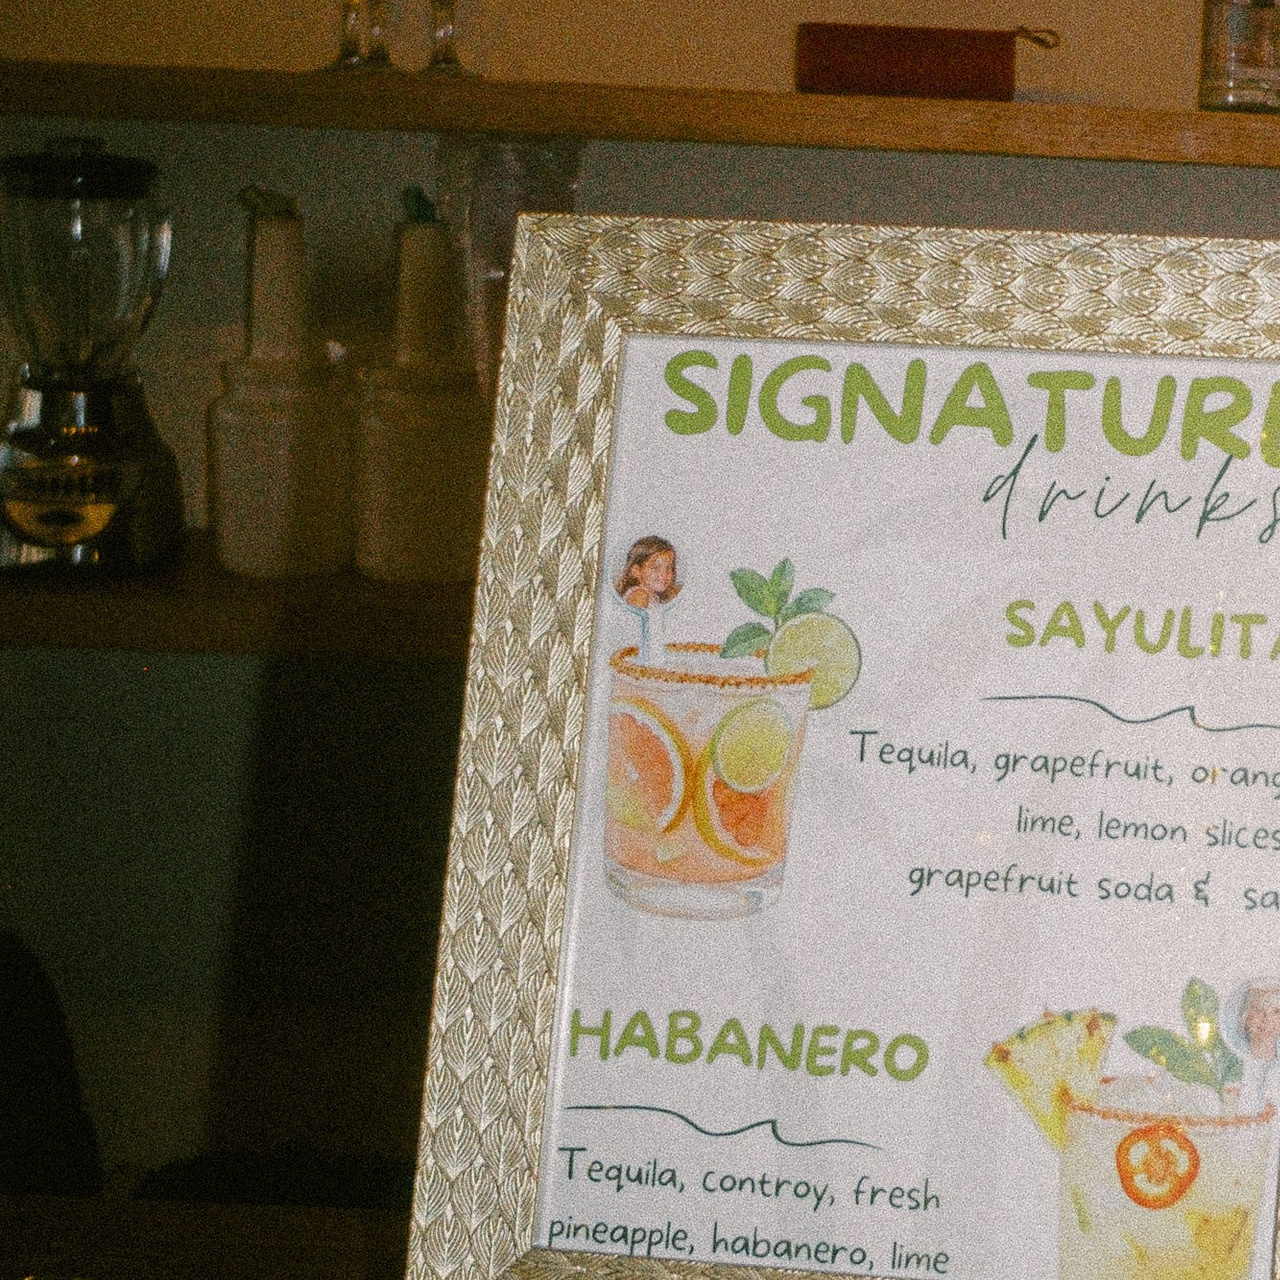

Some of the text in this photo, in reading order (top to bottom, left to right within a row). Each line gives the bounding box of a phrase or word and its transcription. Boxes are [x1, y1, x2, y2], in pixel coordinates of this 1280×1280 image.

[849, 730, 977, 774] Tequila,
[993, 751, 1175, 786] grapefruit,
[1016, 806, 1081, 840] lime,
[1097, 812, 1188, 844] lemon
[908, 862, 1078, 898] grapefruit
[1097, 875, 1175, 903] soda
[1193, 870, 1211, 908] &
[570, 1008, 930, 1082] HABANERO
[557, 1146, 941, 1212] Tequila, controy, fresh
[548, 1216, 950, 1274] pineapple, habanero, lime
